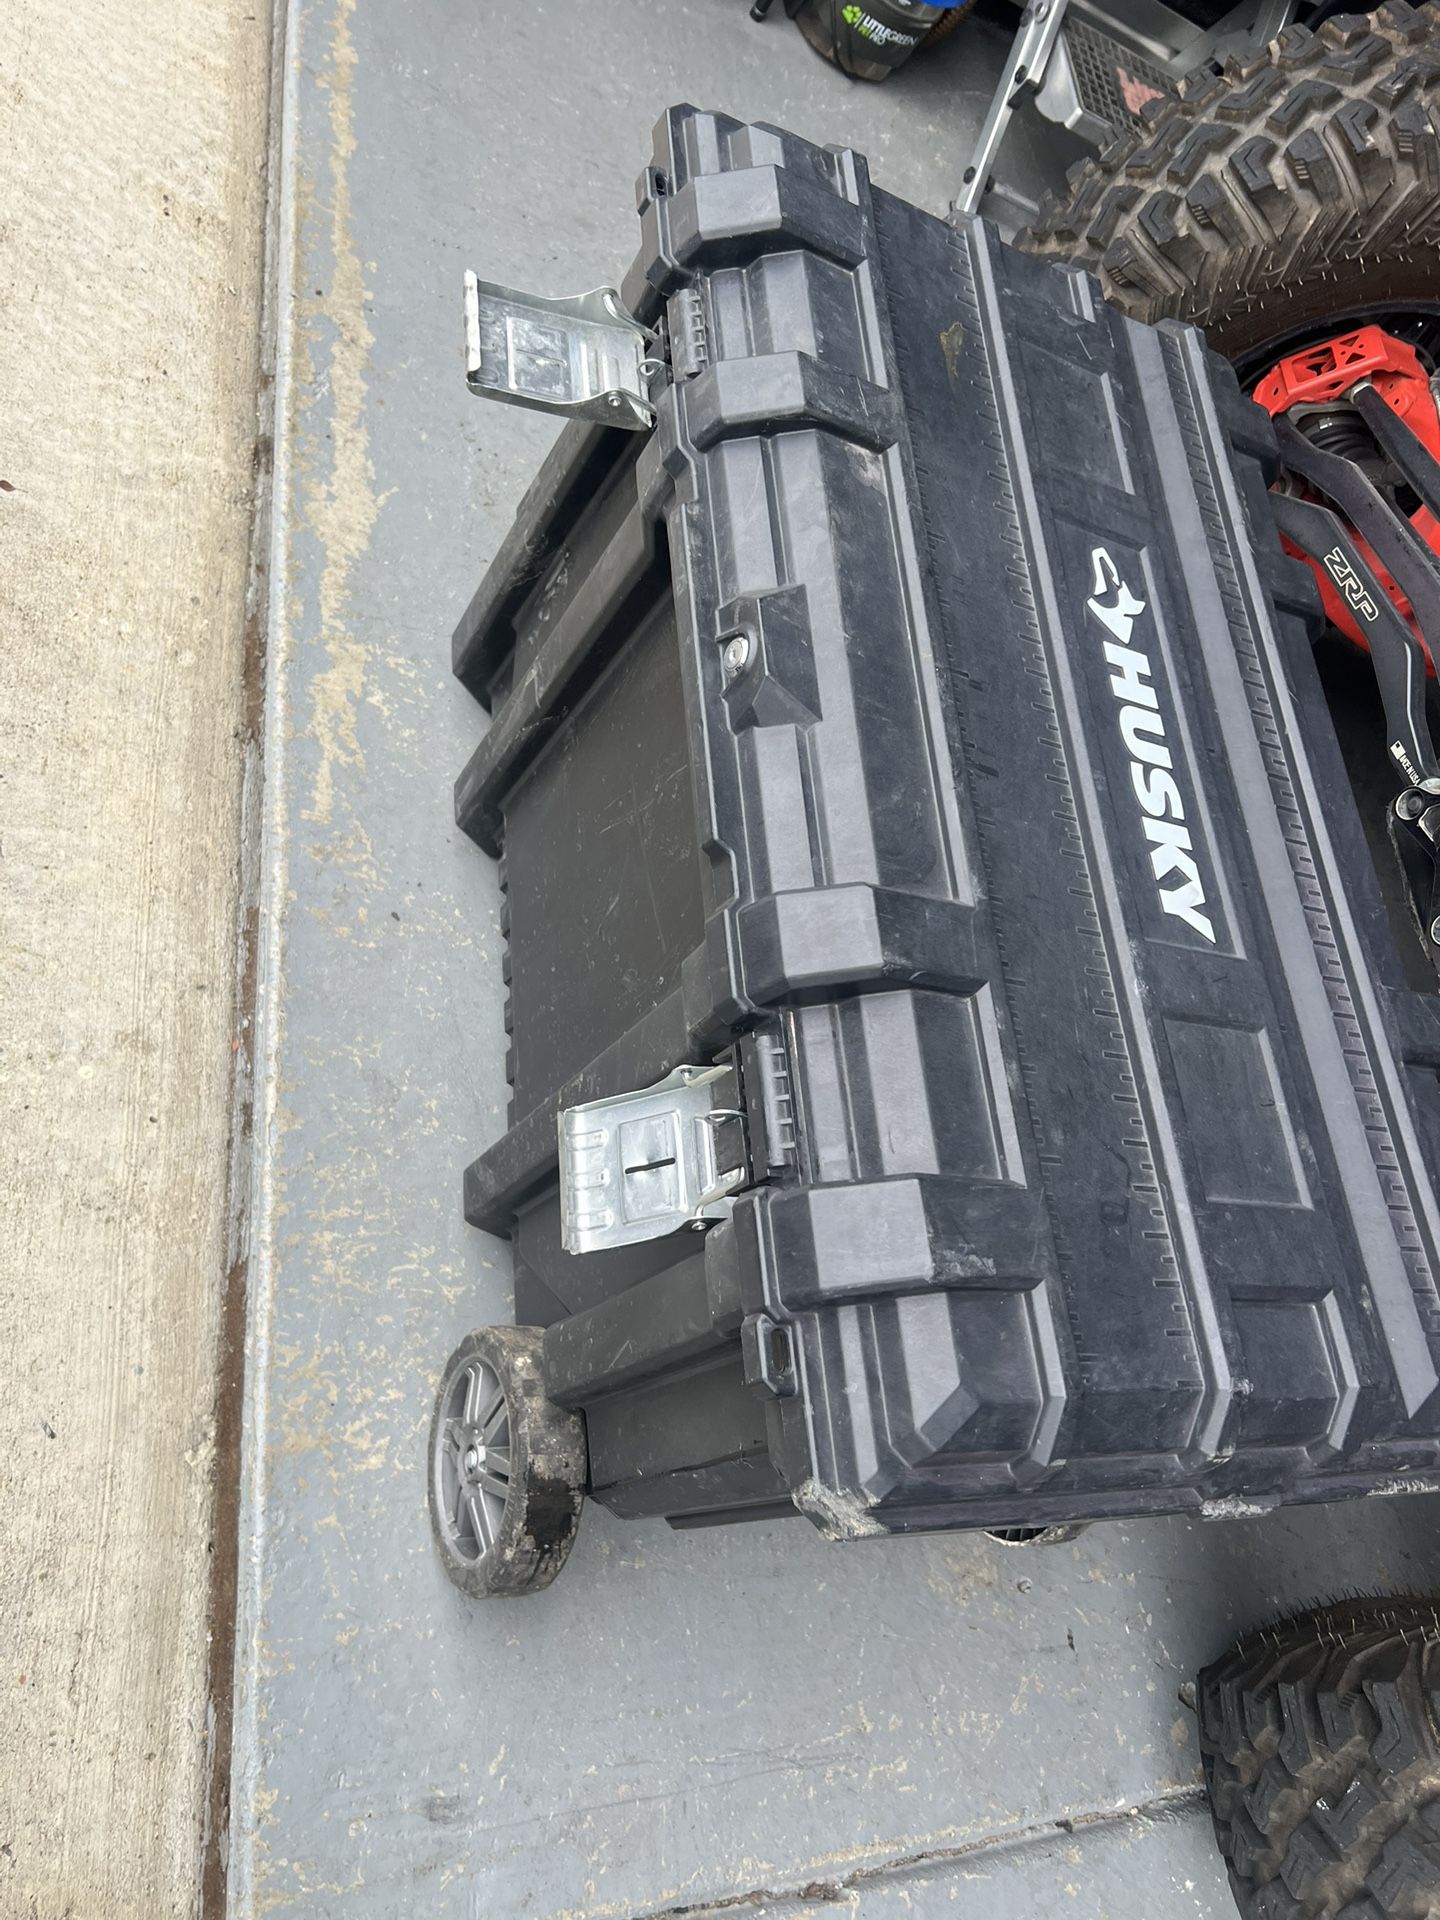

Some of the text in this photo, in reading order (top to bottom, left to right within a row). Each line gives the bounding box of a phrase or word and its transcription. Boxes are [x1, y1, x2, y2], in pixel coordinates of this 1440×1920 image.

[1323, 546, 1379, 622] ZRP
[1103, 641, 1216, 945] HUSKY
[1409, 771, 1421, 786] USA
